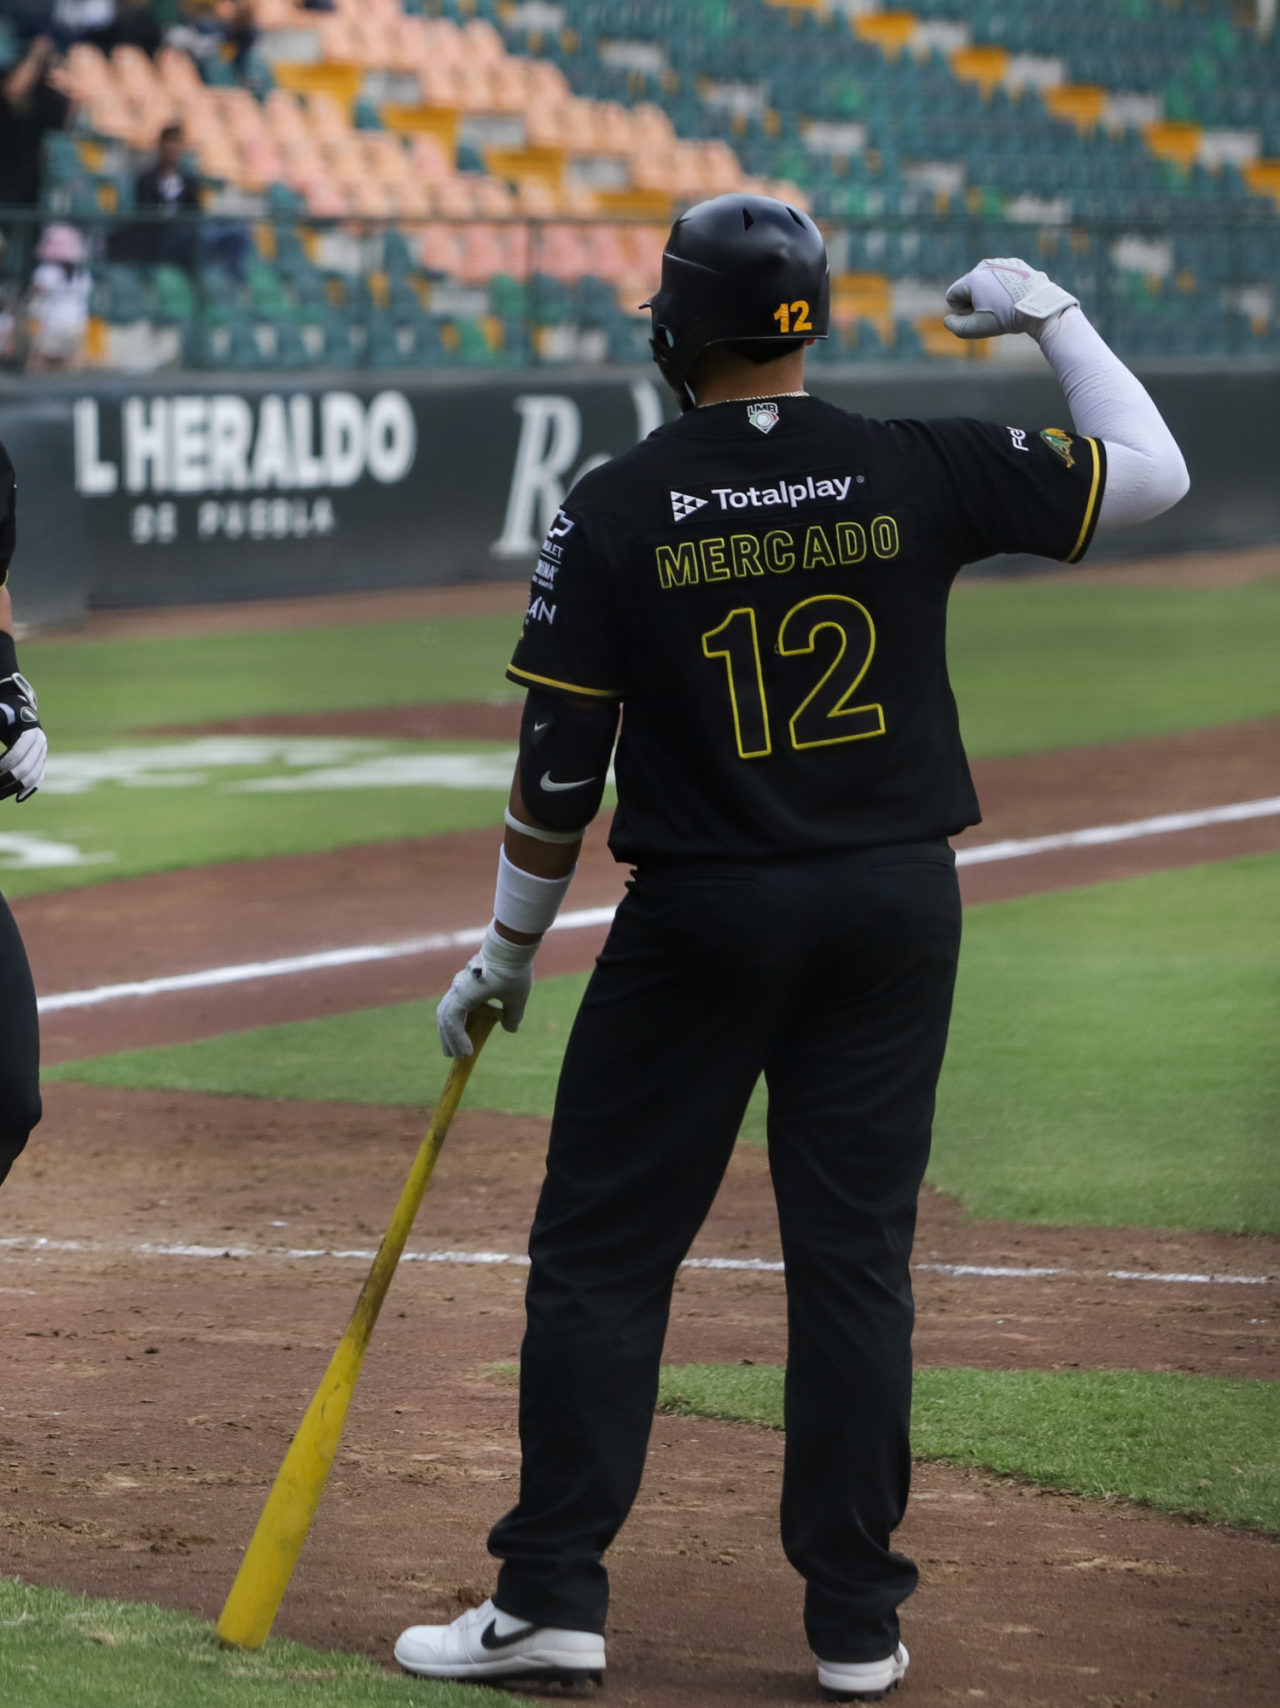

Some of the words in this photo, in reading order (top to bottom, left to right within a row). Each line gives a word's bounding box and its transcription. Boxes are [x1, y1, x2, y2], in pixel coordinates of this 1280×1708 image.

[773, 300, 813, 333] 12
[124, 389, 417, 494] HERALDO
[711, 476, 851, 510] Totalplay
[656, 515, 900, 590] MERCADO
[701, 594, 886, 759] 12
